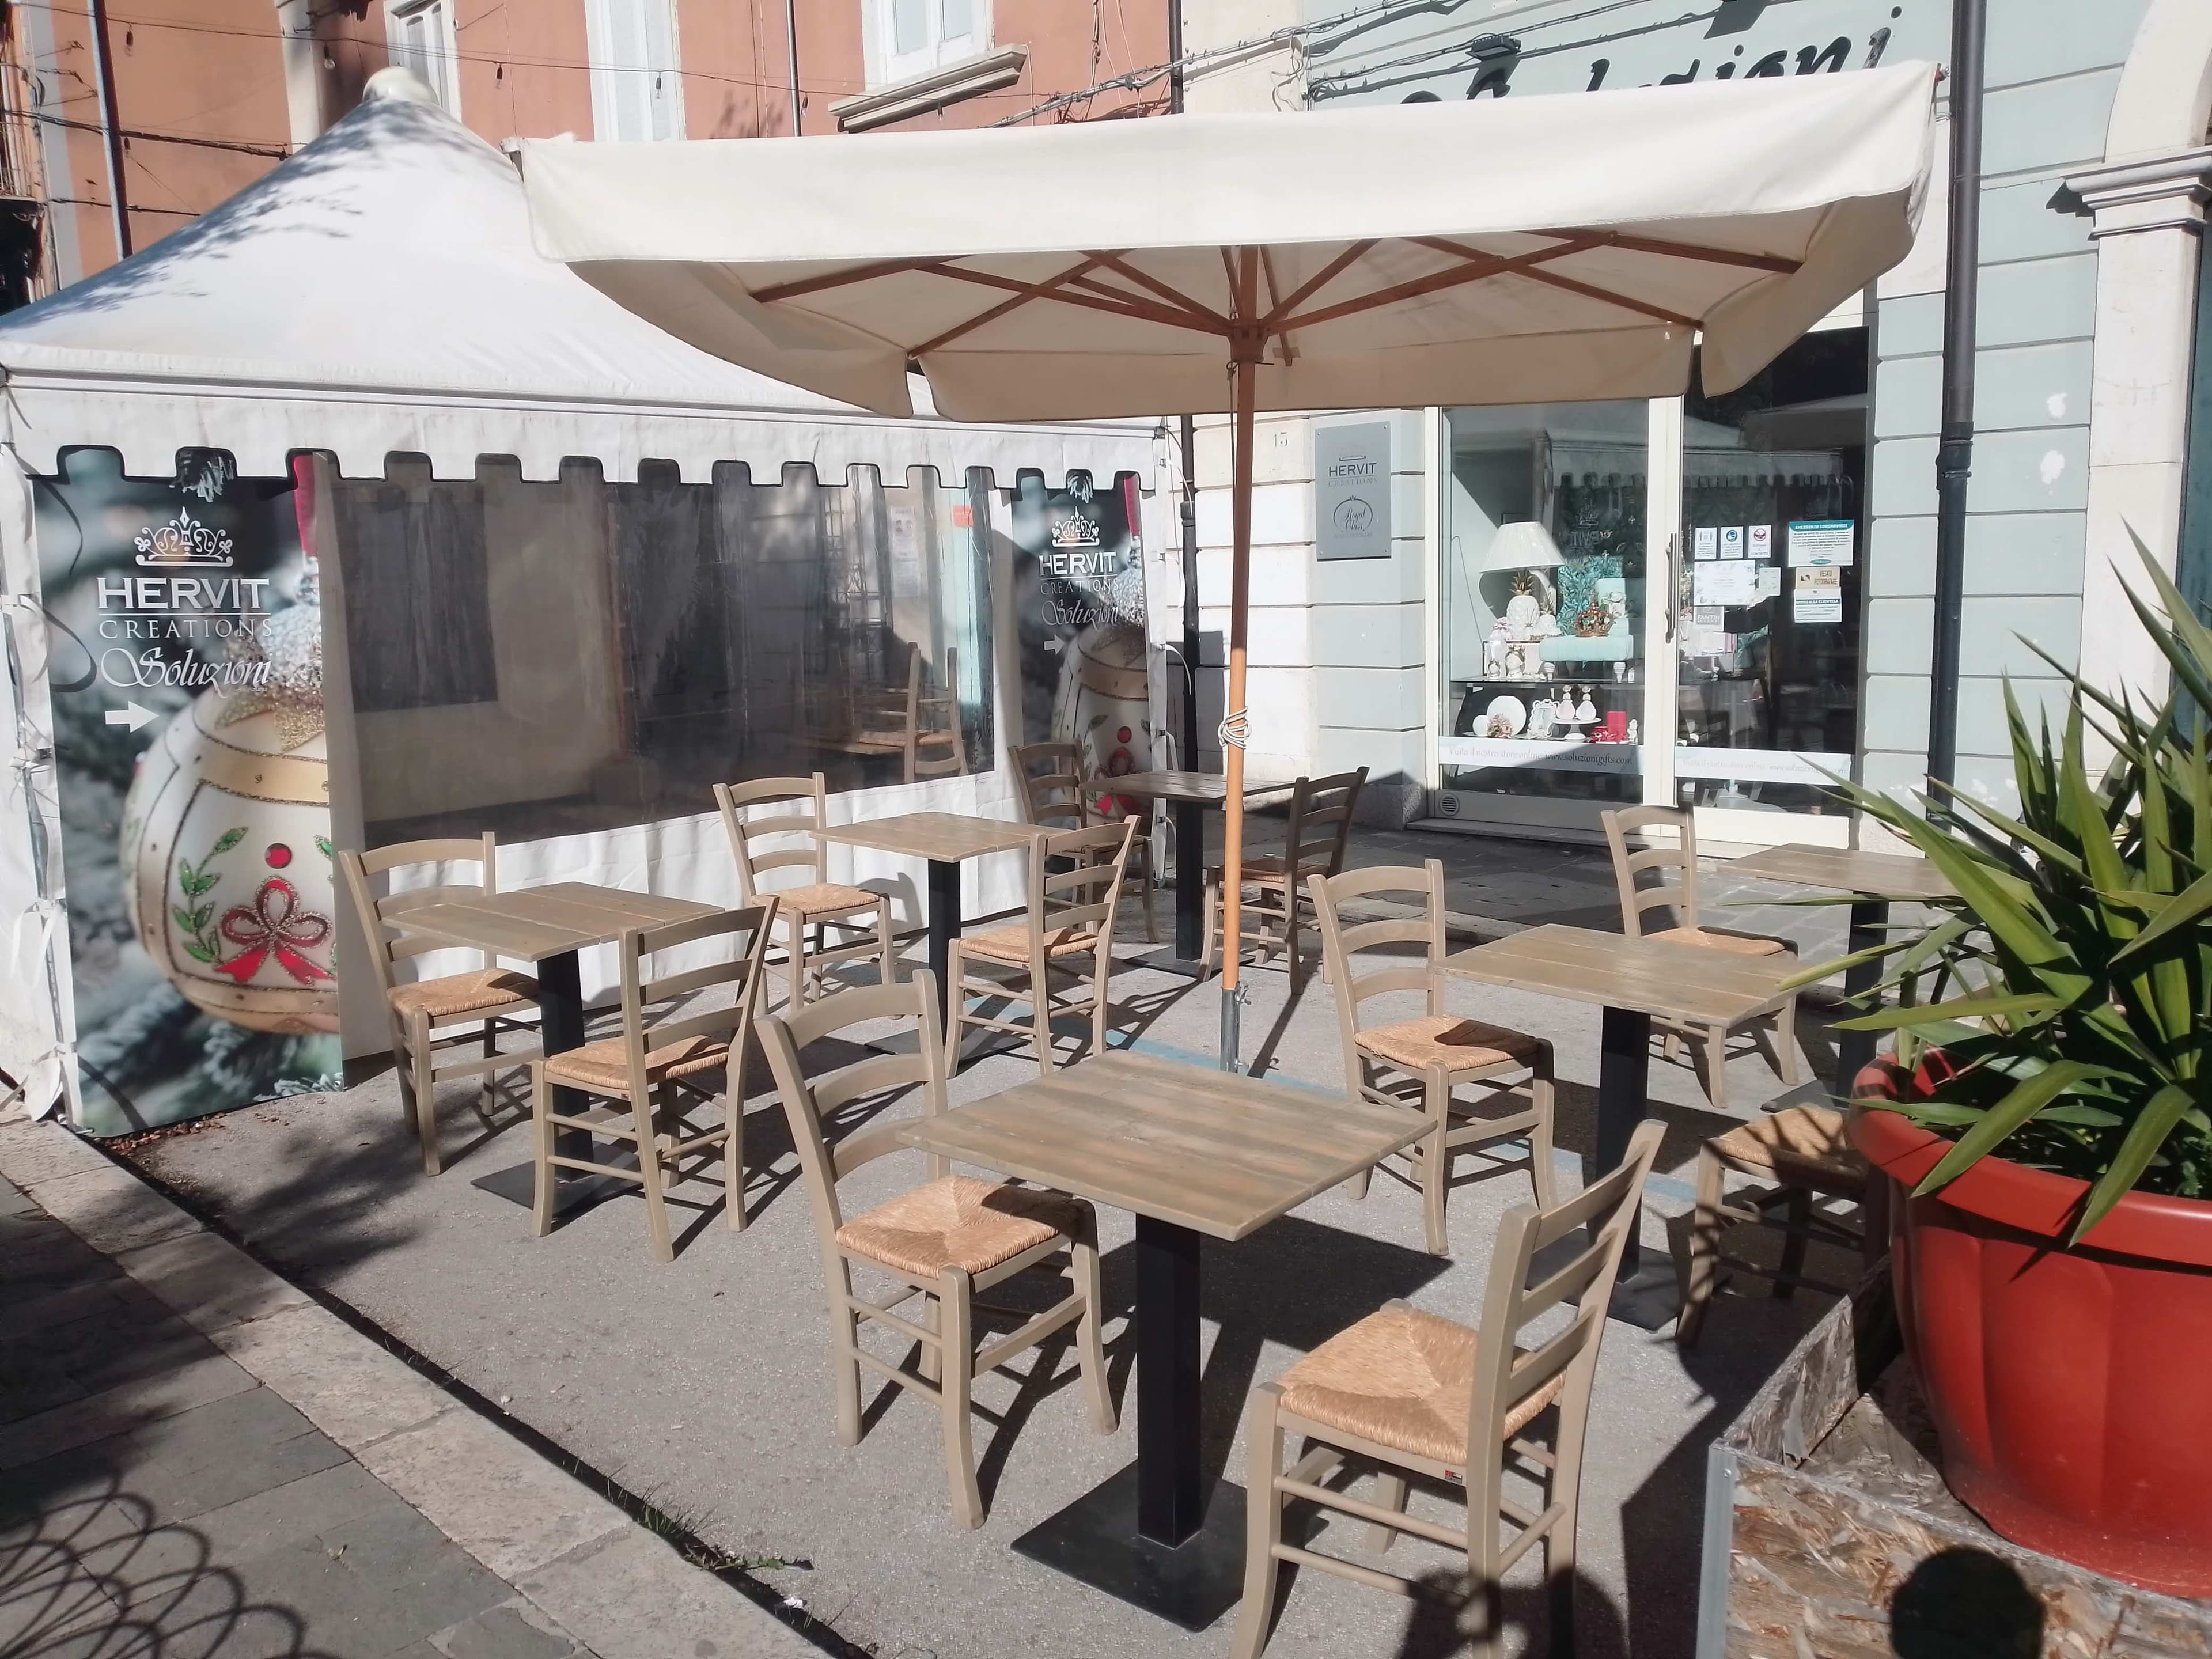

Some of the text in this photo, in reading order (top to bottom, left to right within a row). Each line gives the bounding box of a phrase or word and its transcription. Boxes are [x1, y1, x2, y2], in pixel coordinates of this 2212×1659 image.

[1328, 462, 1377, 478] HERVIT
[1328, 477, 1377, 487] CREATIONS
[1344, 507, 1366, 523] Royal
[1039, 551, 1116, 576] HERVIT
[96, 577, 270, 609] HERVIT
[1040, 578, 1119, 596] CREATIONS
[1041, 599, 1119, 631] Soluzioni
[99, 618, 272, 639] CREATIONS
[100, 646, 271, 699] Soluzioni
[1476, 748, 1499, 757] nostro
[1500, 750, 1517, 758] store
[1545, 751, 1633, 766] www.soluzionigifts.com
